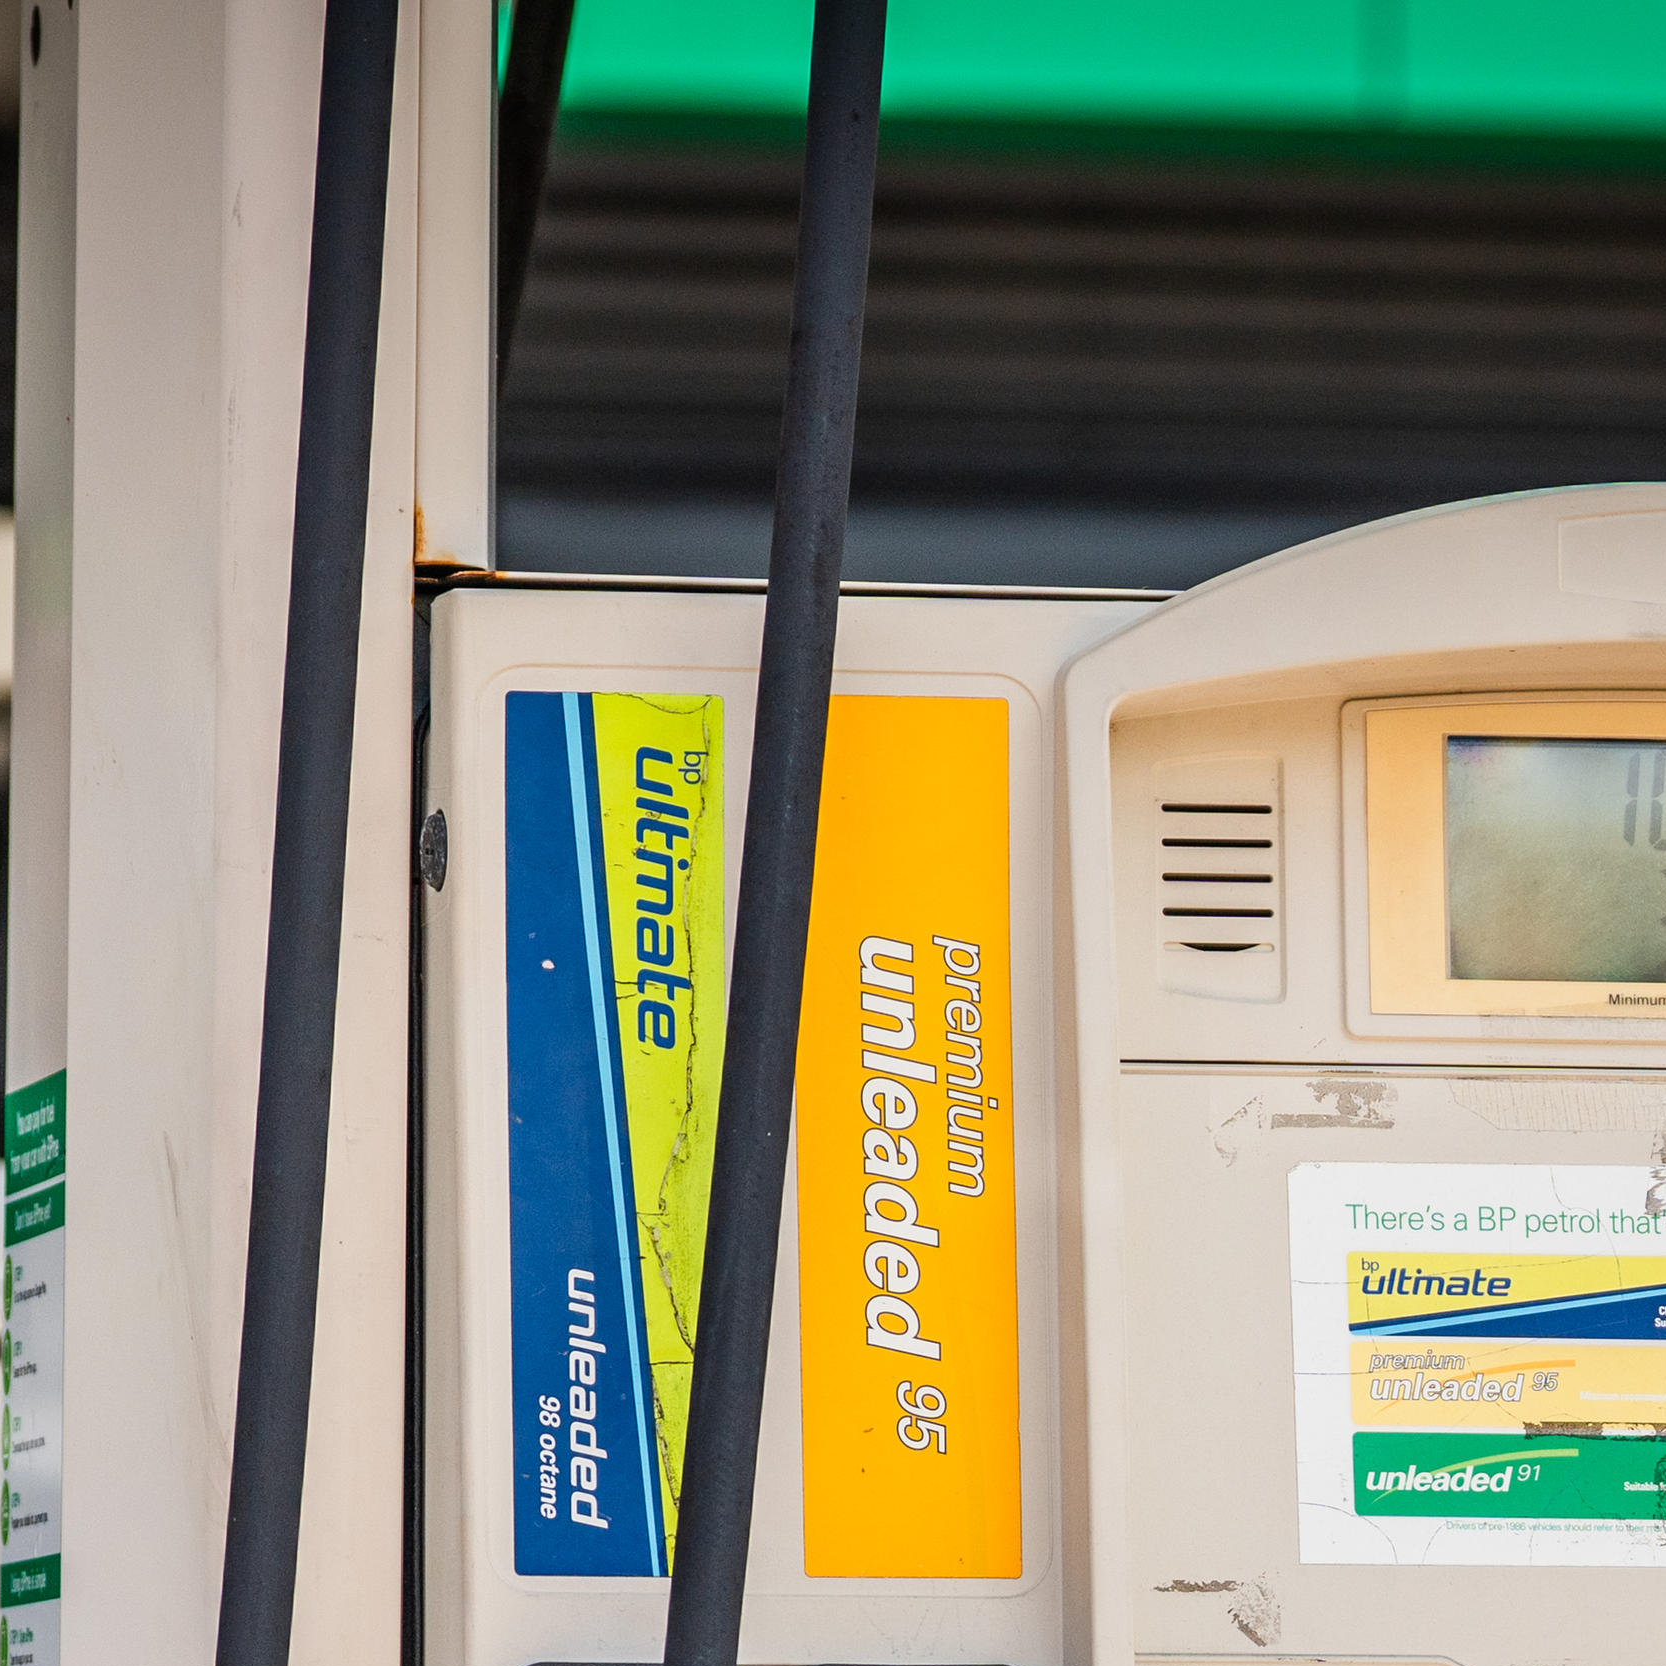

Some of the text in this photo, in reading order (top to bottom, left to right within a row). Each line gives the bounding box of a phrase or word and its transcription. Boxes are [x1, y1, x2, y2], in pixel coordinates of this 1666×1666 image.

[678, 750, 709, 785] bp
[635, 746, 691, 1049] ultimate
[932, 934, 998, 1198] premium
[859, 935, 947, 1455] unleaded 95
[1345, 1203, 1445, 1232] There's
[1453, 1212, 1468, 1231] a
[1478, 1206, 1516, 1232] BP
[1525, 1208, 1601, 1238] petrol
[1361, 1257, 1380, 1273] bp
[1361, 1268, 1512, 1297] ultimate
[1369, 1350, 1465, 1373] premium
[568, 1268, 609, 1529] unleaded
[1370, 1371, 1559, 1402] unleaded 95
[539, 1394, 561, 1519] 98 octane
[1366, 1464, 1542, 1493] unleaded 91
[1623, 1481, 1659, 1491] Suitable
